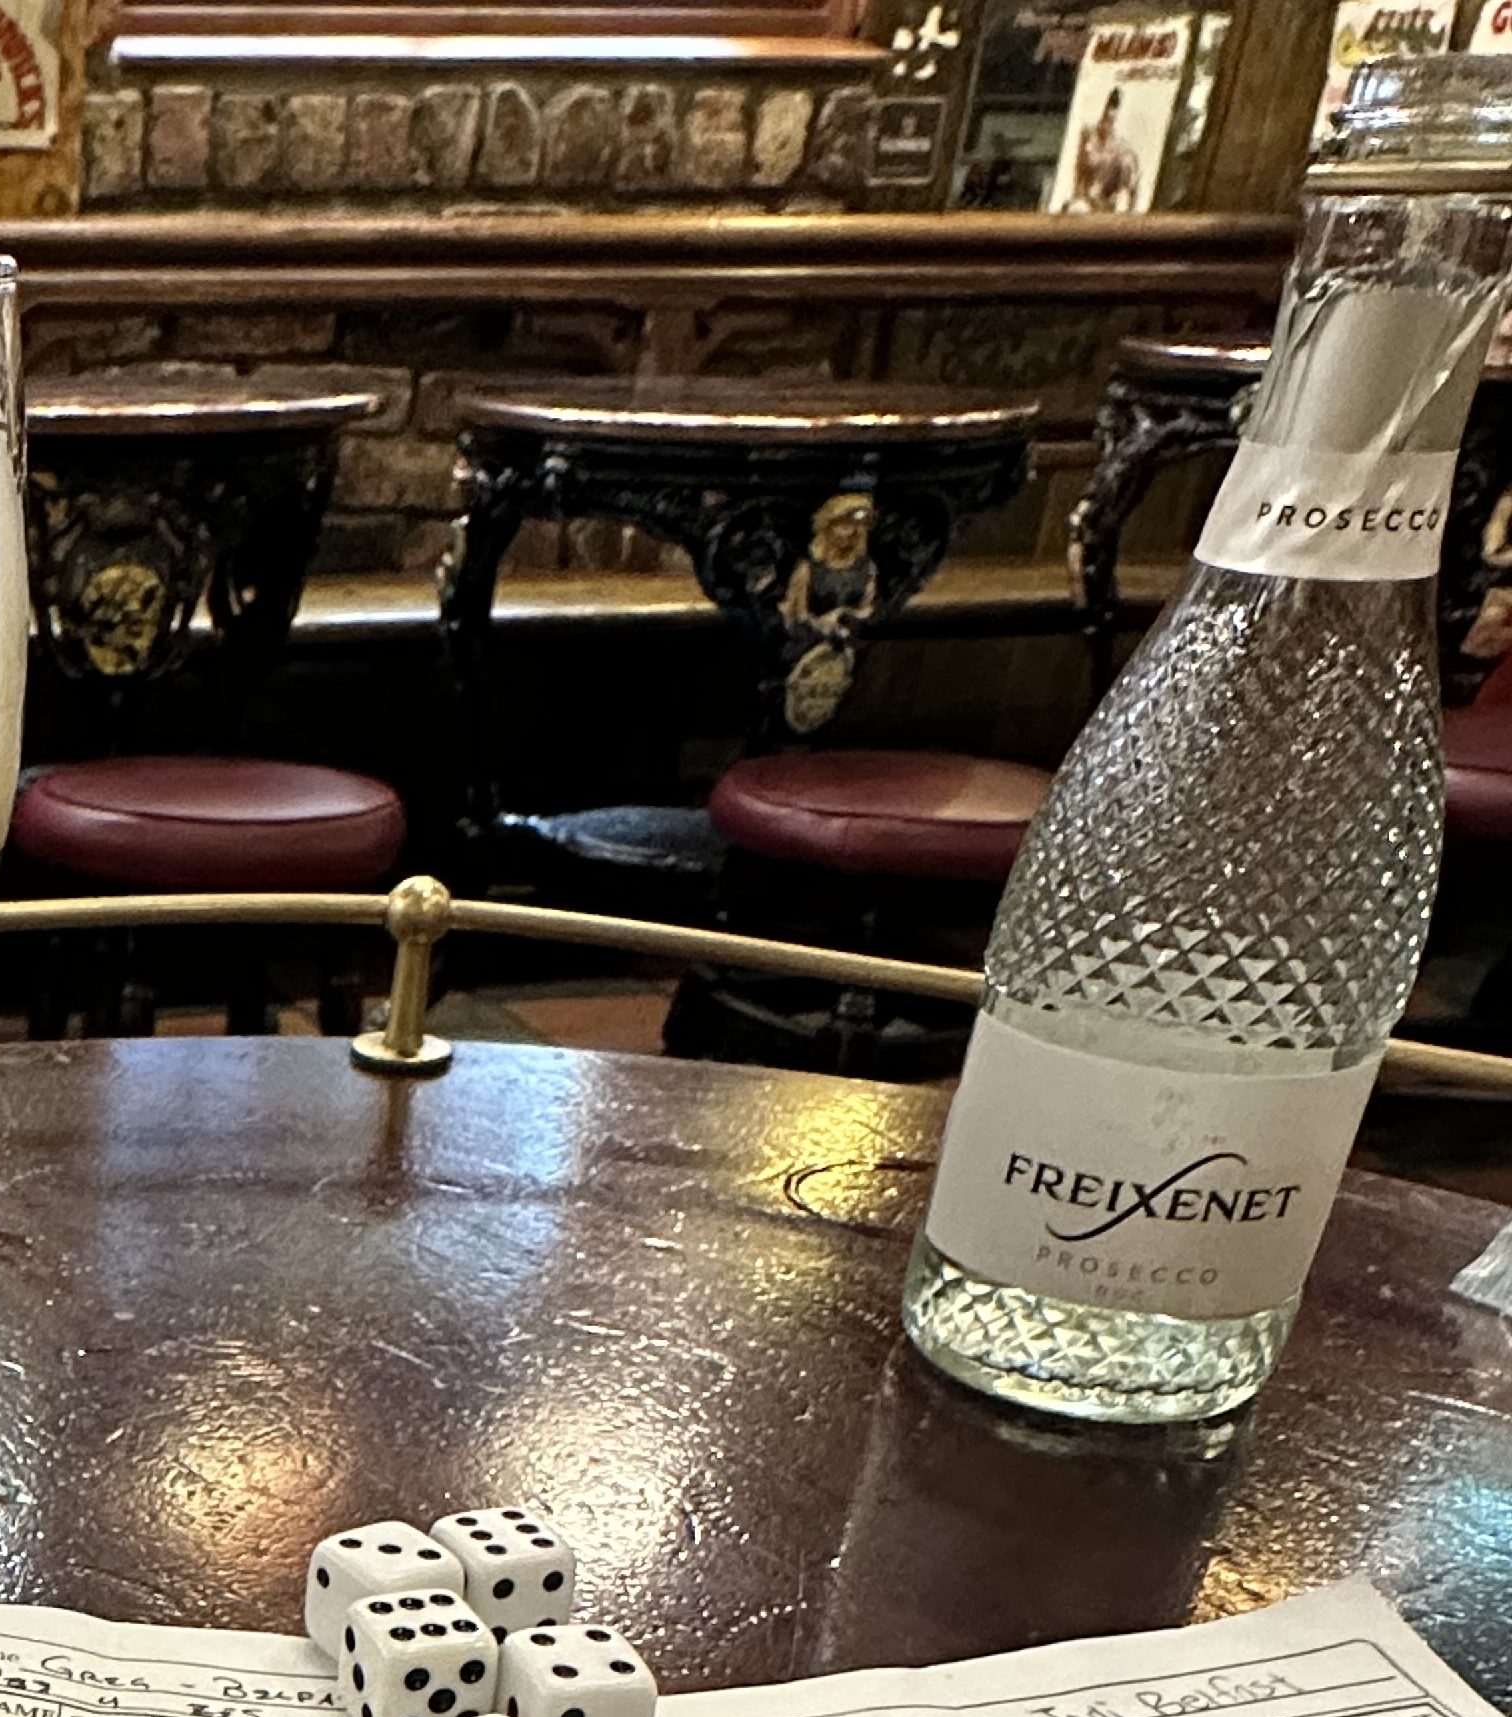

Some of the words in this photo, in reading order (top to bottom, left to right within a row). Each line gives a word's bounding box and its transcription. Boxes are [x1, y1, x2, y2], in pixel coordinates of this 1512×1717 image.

[1257, 501, 1441, 532] PROSECCO
[1004, 1151, 1302, 1236] FREIXENET
[1036, 1244, 1219, 1286] PROSECCO
